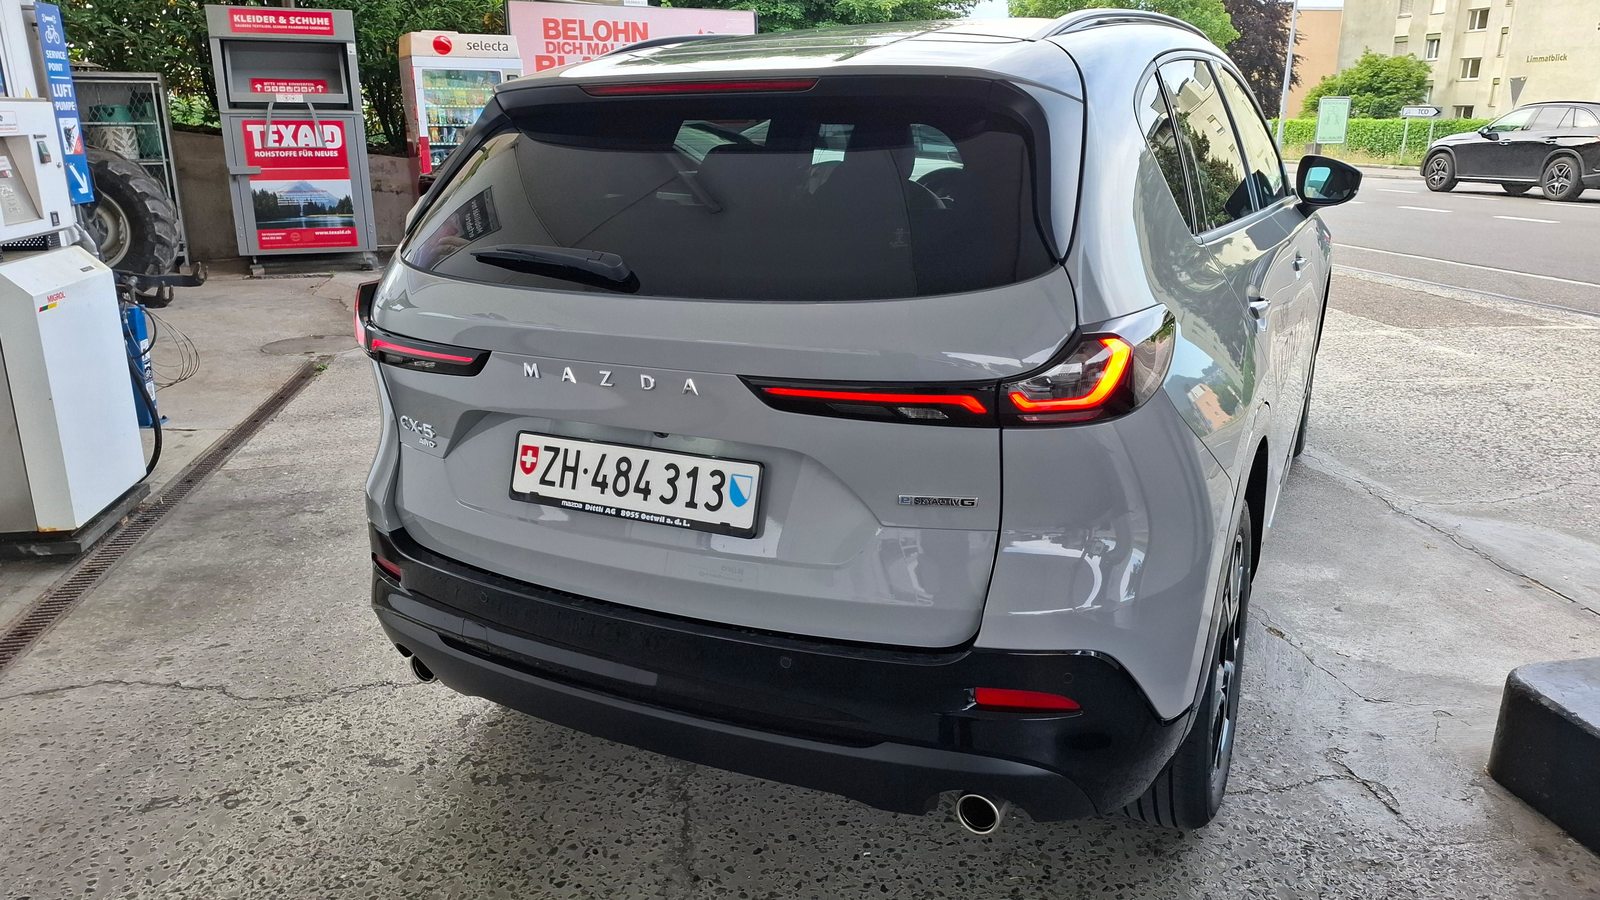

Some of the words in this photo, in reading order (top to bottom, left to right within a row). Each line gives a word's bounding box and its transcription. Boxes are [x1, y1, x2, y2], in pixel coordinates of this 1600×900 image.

[233, 14, 276, 24] KLEIDER
[278, 15, 287, 24] &
[289, 16, 330, 26] SCHUHE
[542, 18, 649, 42] BELOHN
[466, 40, 509, 51] selecta
[545, 41, 583, 55] DICH
[46, 50, 66, 60] SERVICE
[1526, 53, 1568, 63] Limmatblick
[48, 62, 63, 72] POINT
[52, 83, 72, 98] LUFT
[55, 101, 76, 111] PUMPE
[246, 124, 343, 149] TEXAID
[254, 149, 297, 158] ROHSTOFFE
[298, 148, 313, 157] FÜR
[47, 291, 66, 303] MIGROL
[523, 362, 699, 396] MAZDA
[400, 415, 436, 439] CX-5
[561, 500, 583, 509] mazda
[585, 503, 604, 513] Dittli
[605, 507, 616, 515] AG
[620, 509, 640, 519] 8955
